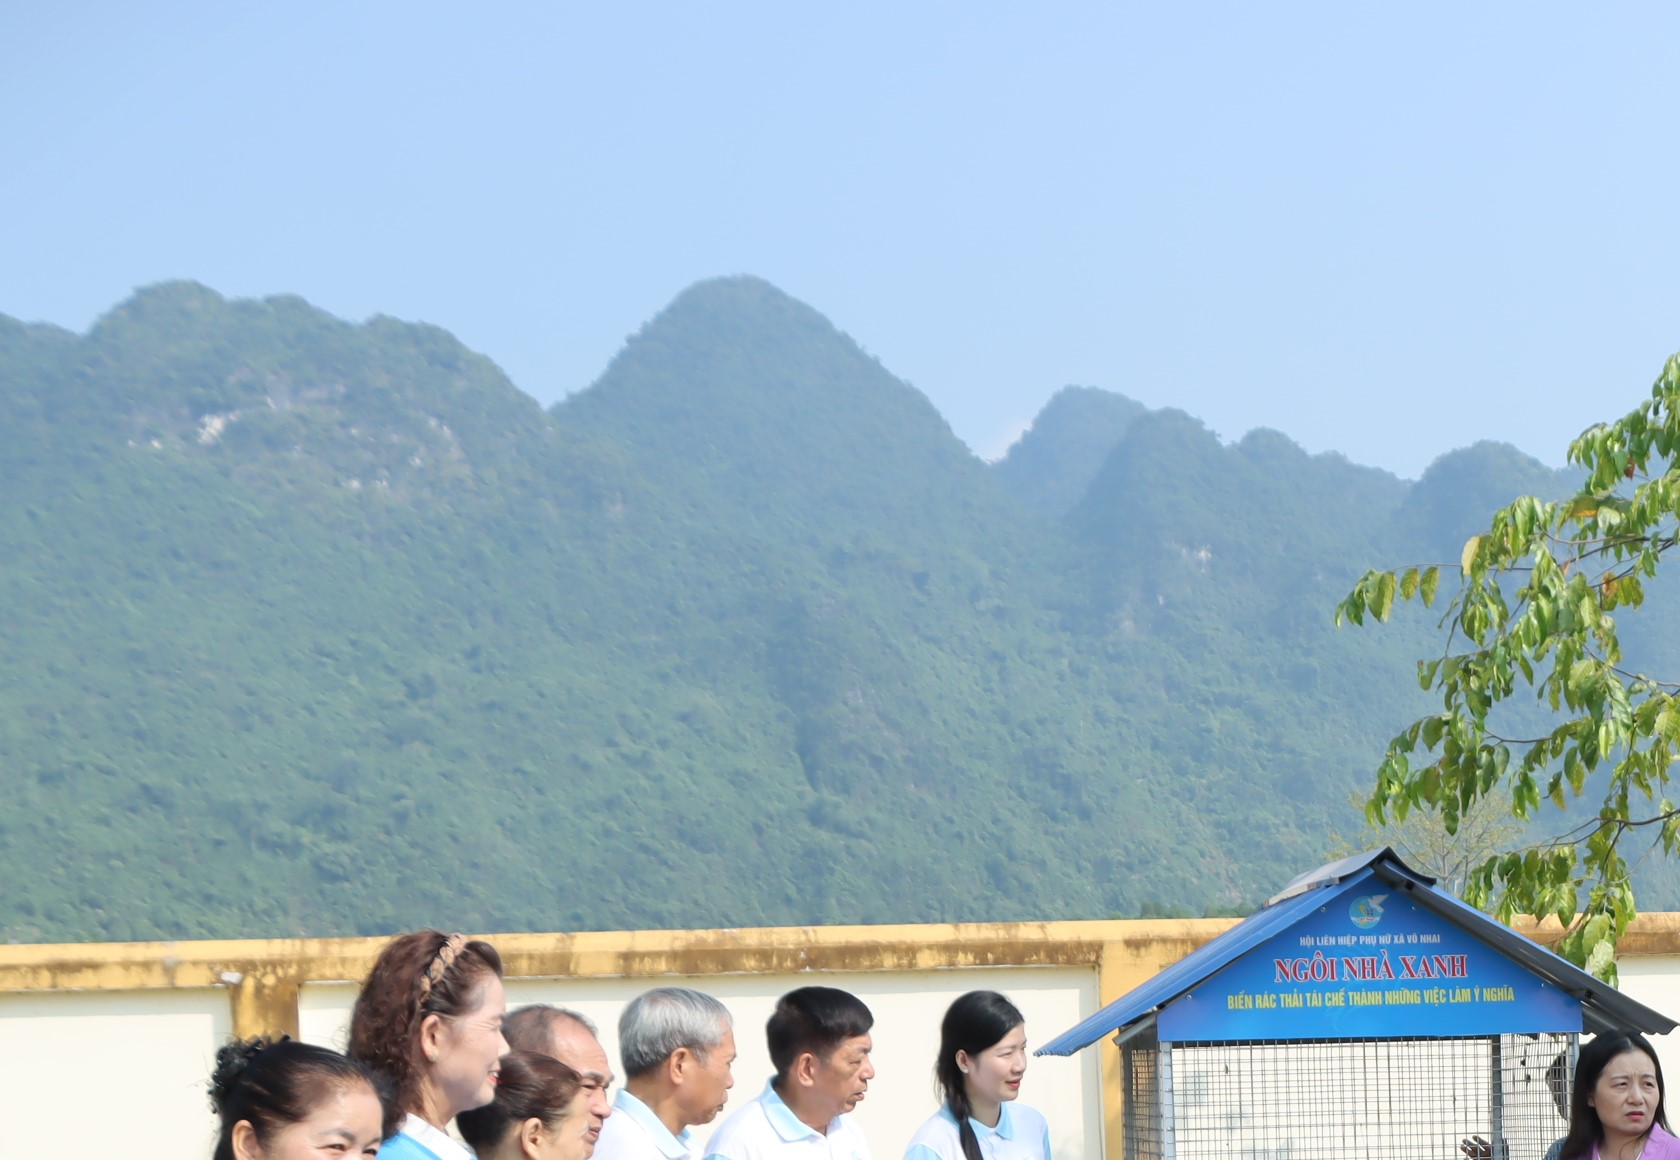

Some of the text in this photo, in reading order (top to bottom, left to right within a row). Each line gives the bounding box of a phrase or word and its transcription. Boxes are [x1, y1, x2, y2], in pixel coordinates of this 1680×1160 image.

[1299, 935, 1314, 948] HỘI
[1316, 934, 1336, 946] LIÊN
[1337, 933, 1357, 948] HIỆP
[1359, 935, 1377, 947] PHỤ
[1378, 933, 1392, 945] NỮ
[1419, 933, 1440, 944] NHAI
[1274, 949, 1468, 983] NGÔI NHÀ XANH
[1227, 984, 1515, 1010] BIẾN RÁC THẢI TÁI CHẾ THÀNH NHỮNG VIỆC LÀM Ý NGHĨA
